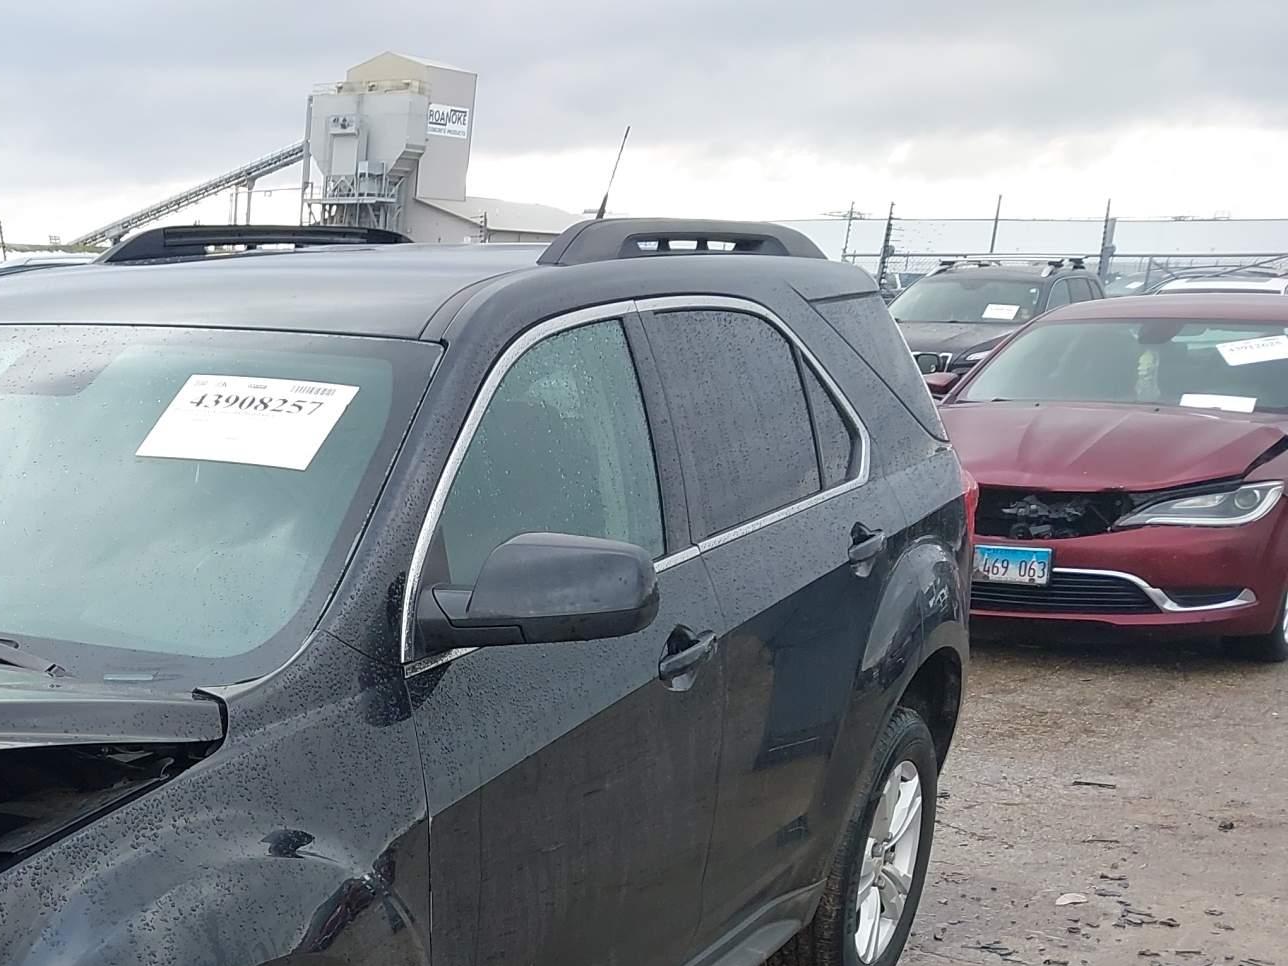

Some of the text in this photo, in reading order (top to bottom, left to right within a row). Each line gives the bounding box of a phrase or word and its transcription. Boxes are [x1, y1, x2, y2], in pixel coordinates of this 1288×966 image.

[428, 109, 467, 126] ROANOKE
[189, 393, 324, 416] 43908257
[983, 557, 1046, 579] 469 063
